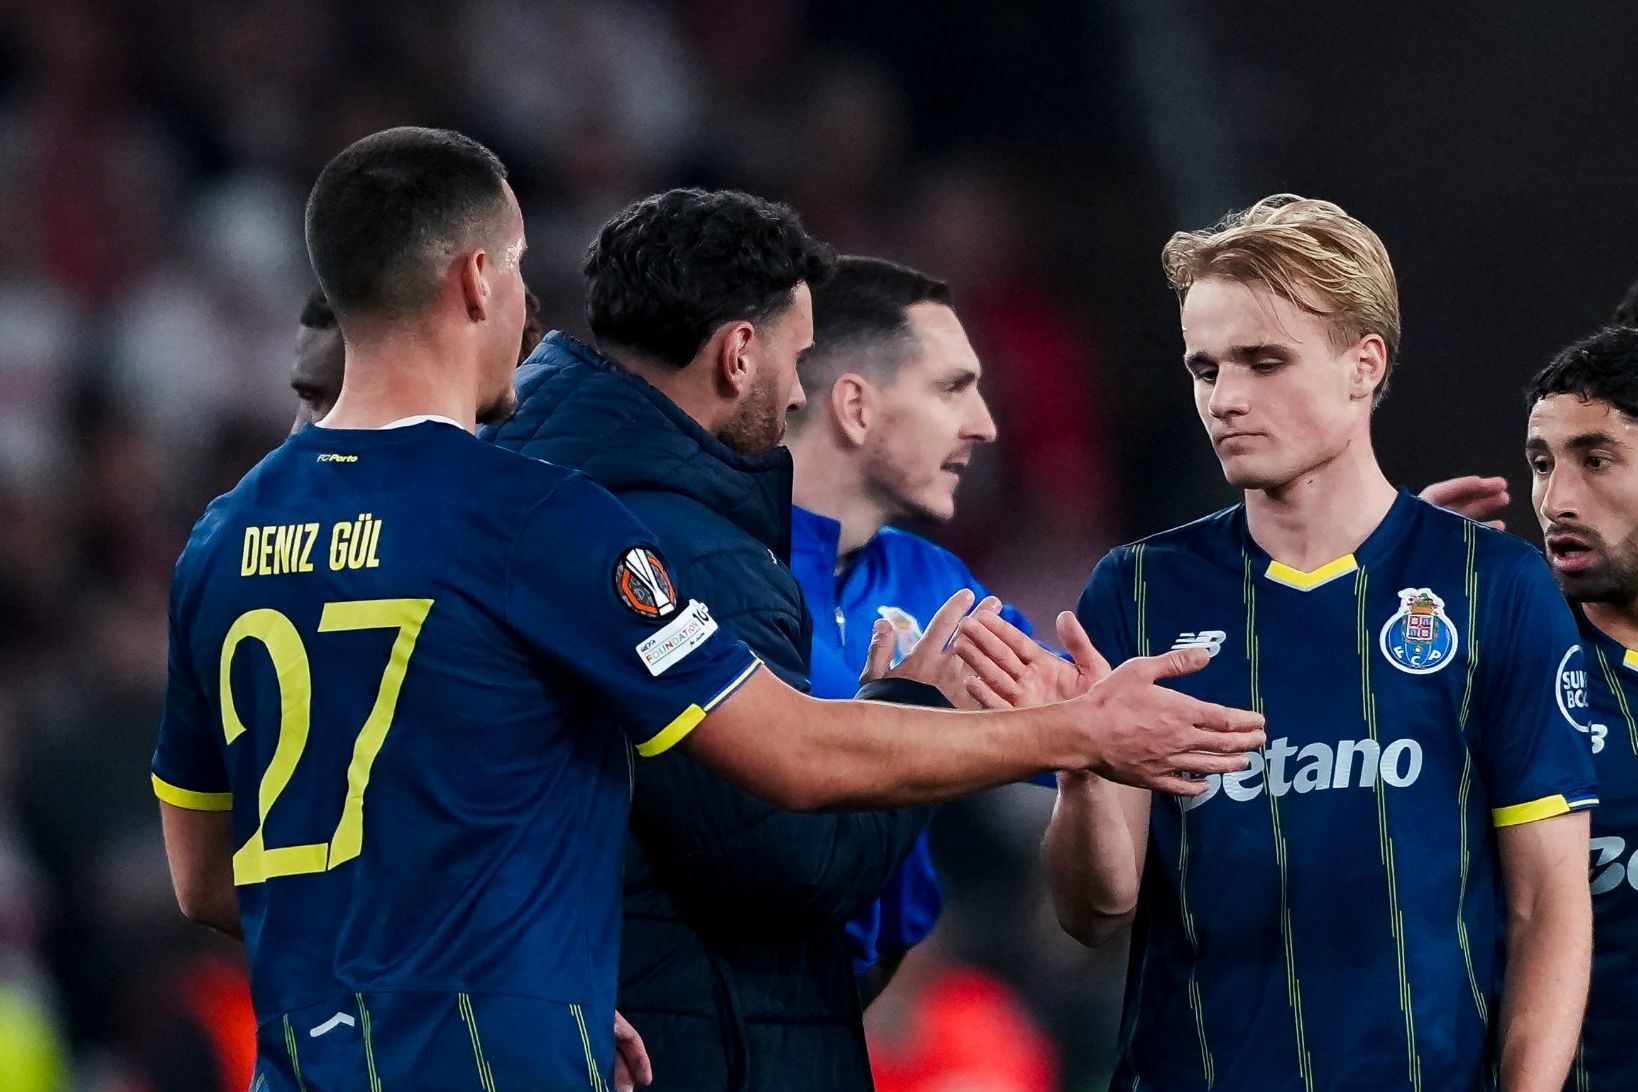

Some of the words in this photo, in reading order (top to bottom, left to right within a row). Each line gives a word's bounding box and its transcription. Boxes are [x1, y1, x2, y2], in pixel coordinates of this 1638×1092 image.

[240, 522, 320, 577] DENIZ
[328, 513, 383, 572] GÜL
[219, 597, 435, 886] 27
